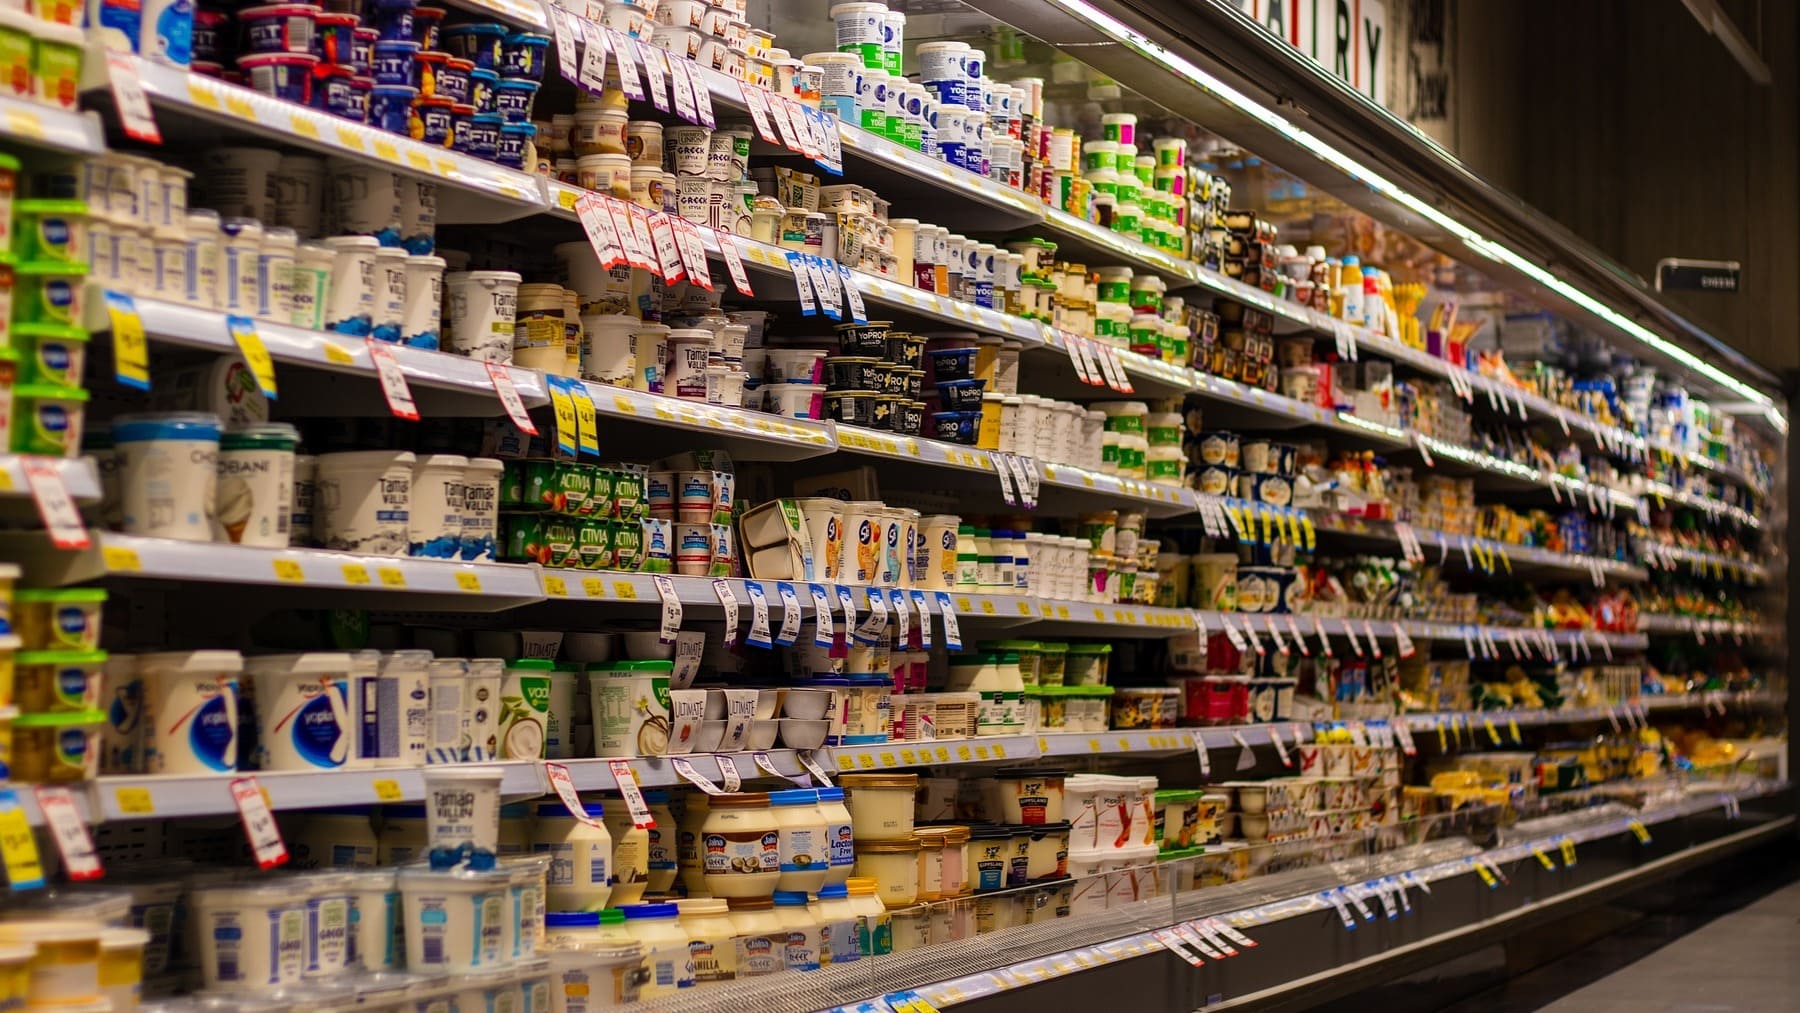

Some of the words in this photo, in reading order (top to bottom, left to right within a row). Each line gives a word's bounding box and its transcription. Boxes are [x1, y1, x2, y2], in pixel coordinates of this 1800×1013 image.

[497, 94, 527, 108] FiT
[470, 130, 498, 145] FiT
[677, 146, 705, 154] GREEK
[680, 196, 708, 204] GREEK
[491, 291, 517, 307] Tama
[858, 330, 883, 340] YoPRO
[959, 387, 981, 397] YoPRO
[560, 473, 591, 491] ACTIVIA
[615, 481, 640, 497] ACTIVIA
[580, 527, 608, 545] CTIVIA
[615, 531, 640, 546] ACTIVIA
[675, 700, 703, 718] ULTIMATE
[728, 700, 755, 717] ULTIMATE
[707, 838, 724, 847] Jalna
[764, 836, 777, 845] Jaln
[831, 839, 852, 849] Lacto
[840, 848, 851, 857] Fre
